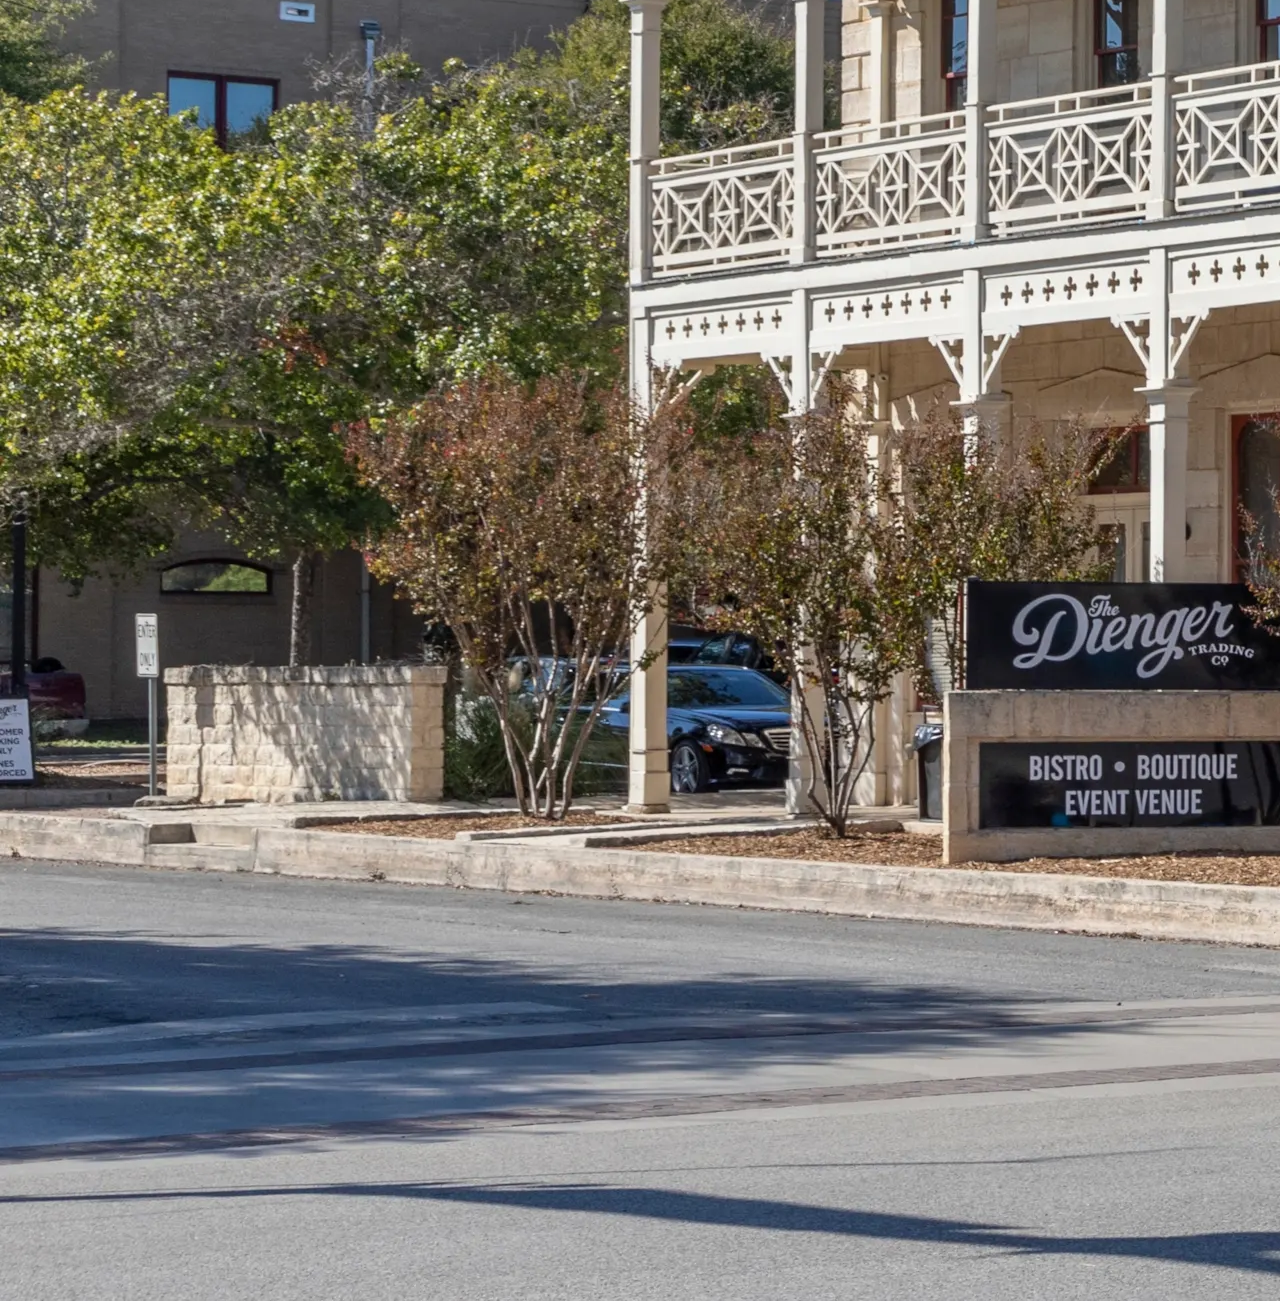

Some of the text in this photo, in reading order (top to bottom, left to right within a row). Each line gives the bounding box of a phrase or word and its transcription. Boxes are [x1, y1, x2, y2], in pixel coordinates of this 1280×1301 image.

[1087, 594, 1121, 619] The
[137, 624, 157, 639] ENTER
[1011, 592, 1235, 679] Dienger
[140, 652, 156, 667] ONLY
[1188, 643, 1255, 660] TRADING
[1029, 753, 1239, 782] BISTRO BOUTIQUE
[1064, 788, 1203, 816] EVENT VENUE
